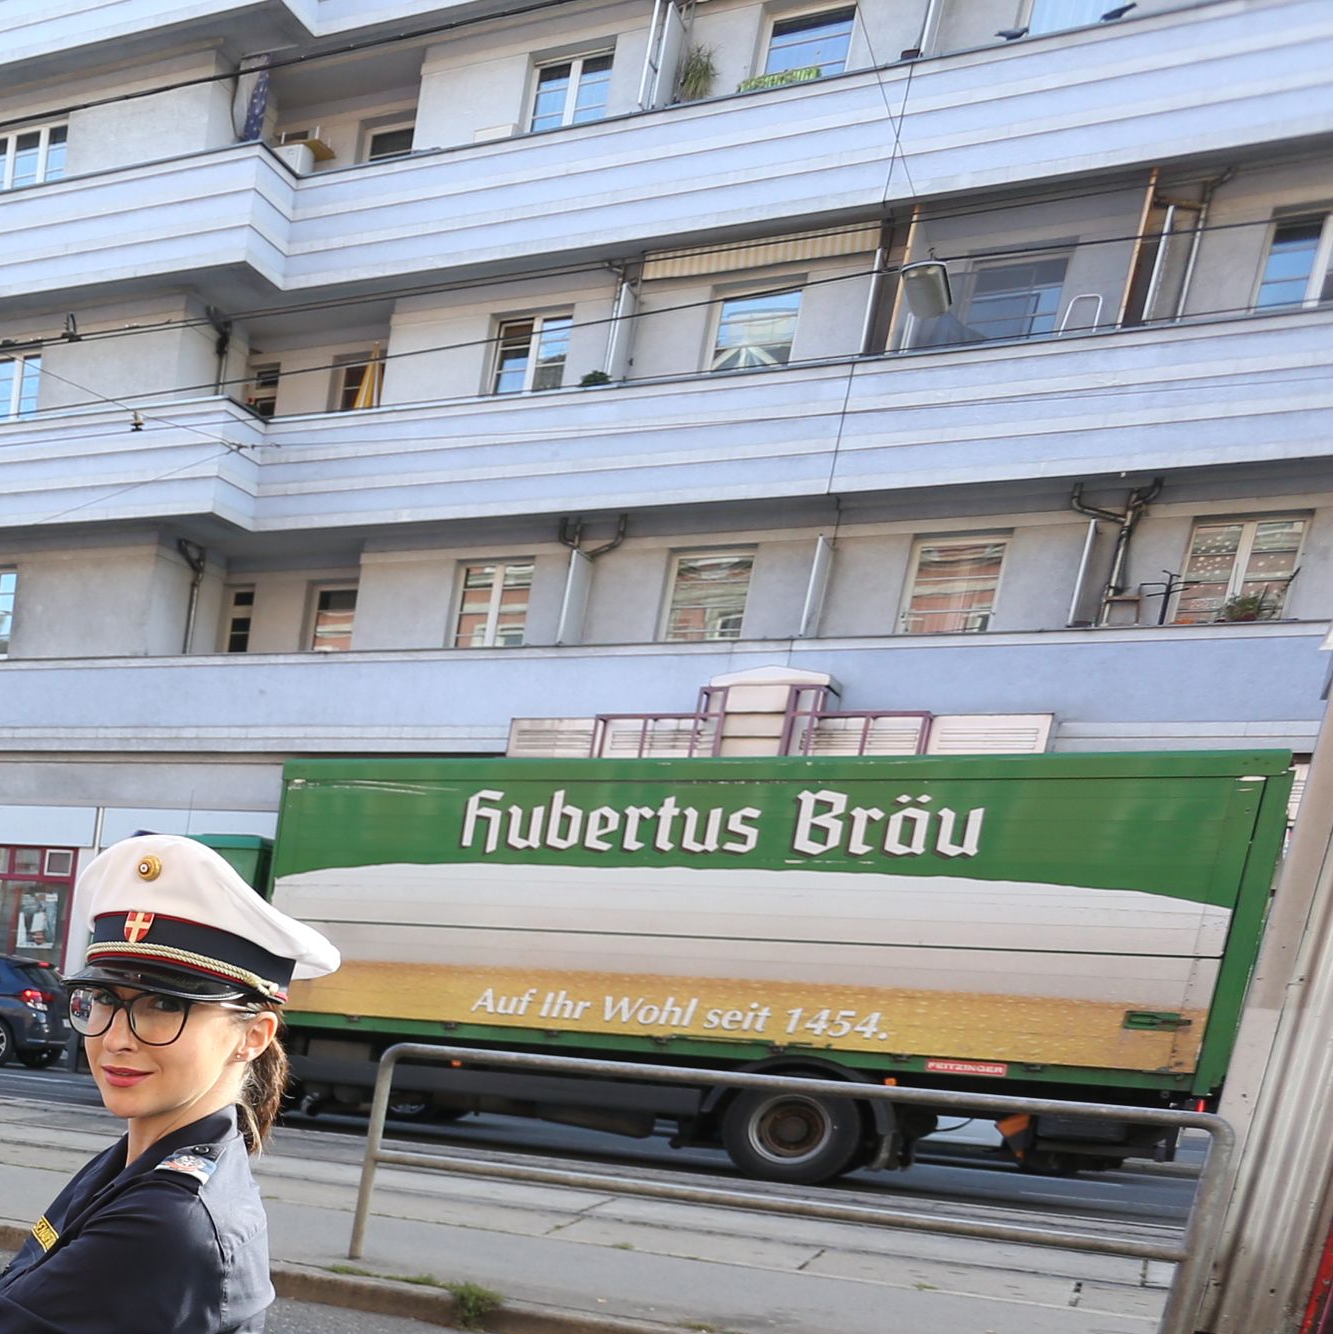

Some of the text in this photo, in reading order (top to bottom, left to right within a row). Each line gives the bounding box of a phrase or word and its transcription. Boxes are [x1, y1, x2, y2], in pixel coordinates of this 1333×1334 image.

[461, 789, 986, 857] Hubertus Bräu
[471, 987, 891, 1042] Auf Ihr Wohl seit 1454.
